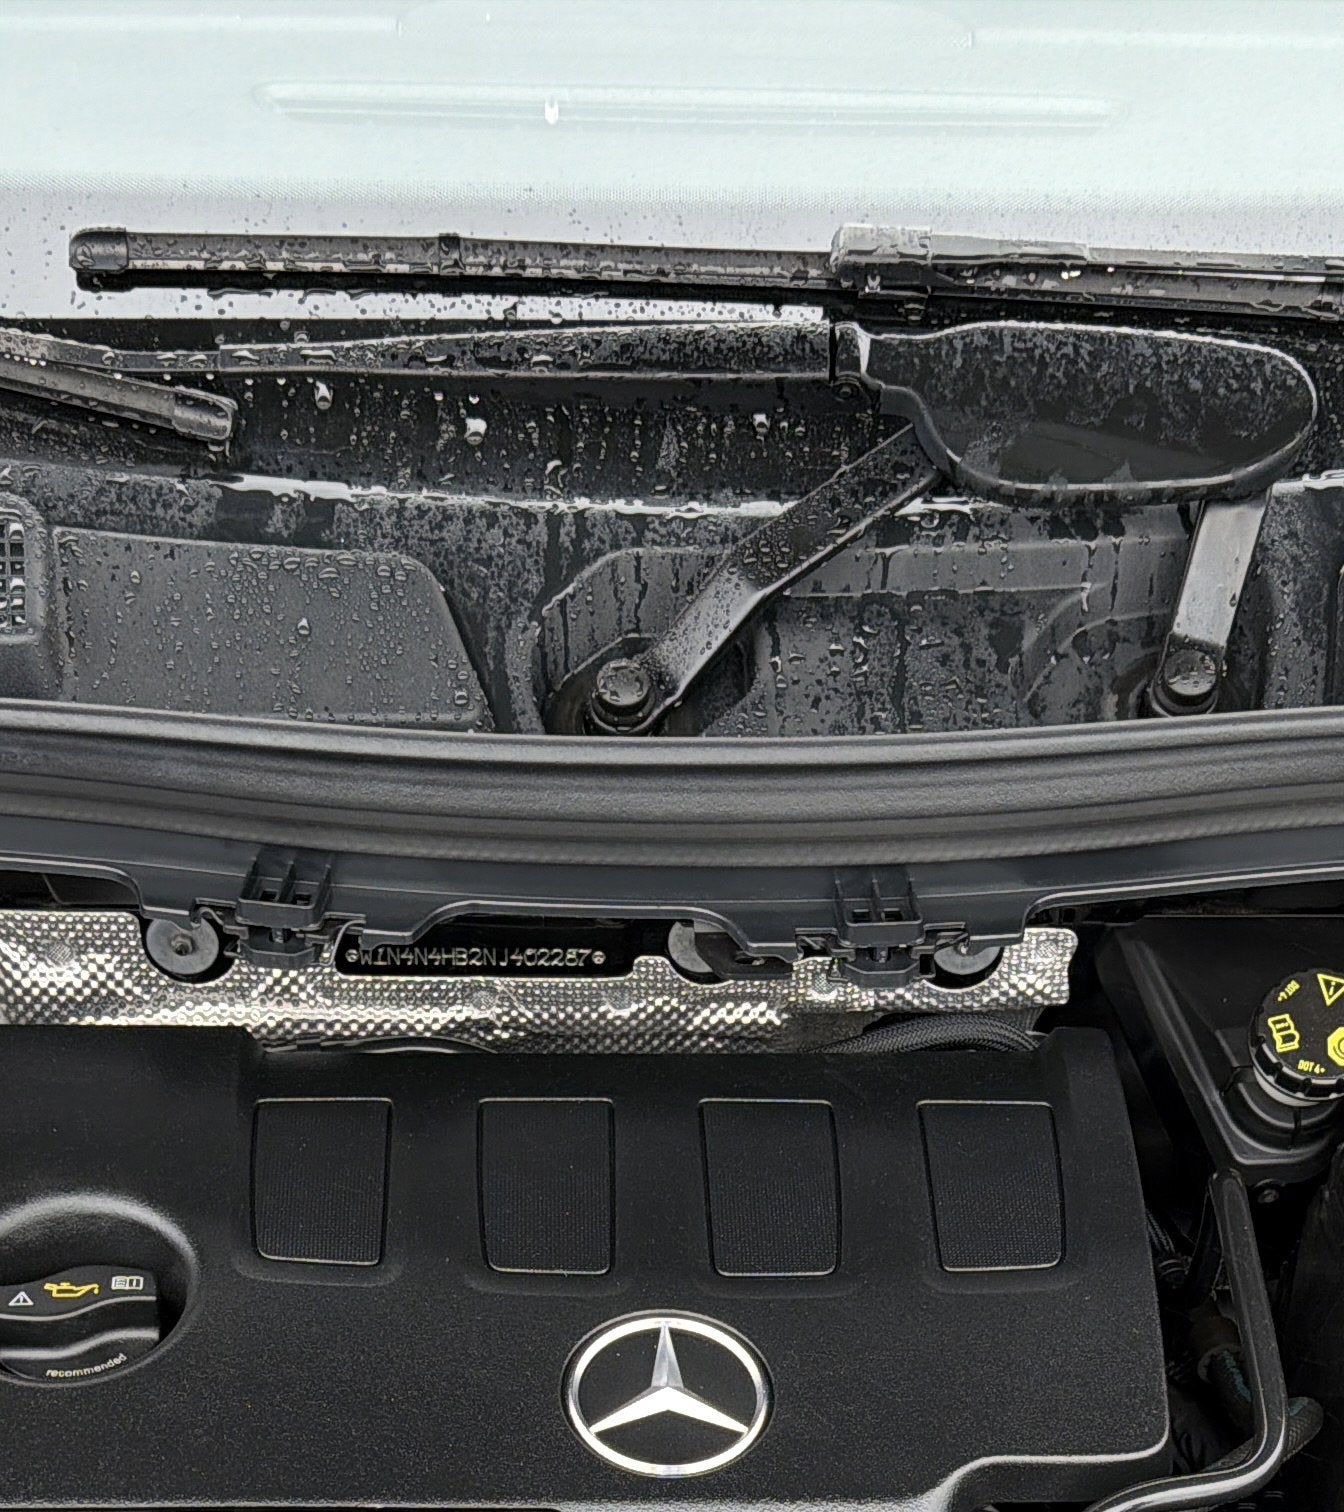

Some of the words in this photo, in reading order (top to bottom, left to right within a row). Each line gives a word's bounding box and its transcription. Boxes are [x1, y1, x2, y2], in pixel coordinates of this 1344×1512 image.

[1298, 1060, 1315, 1073] DOT
[1314, 1064, 1326, 1075] 4+
[45, 1353, 127, 1378] recommended
